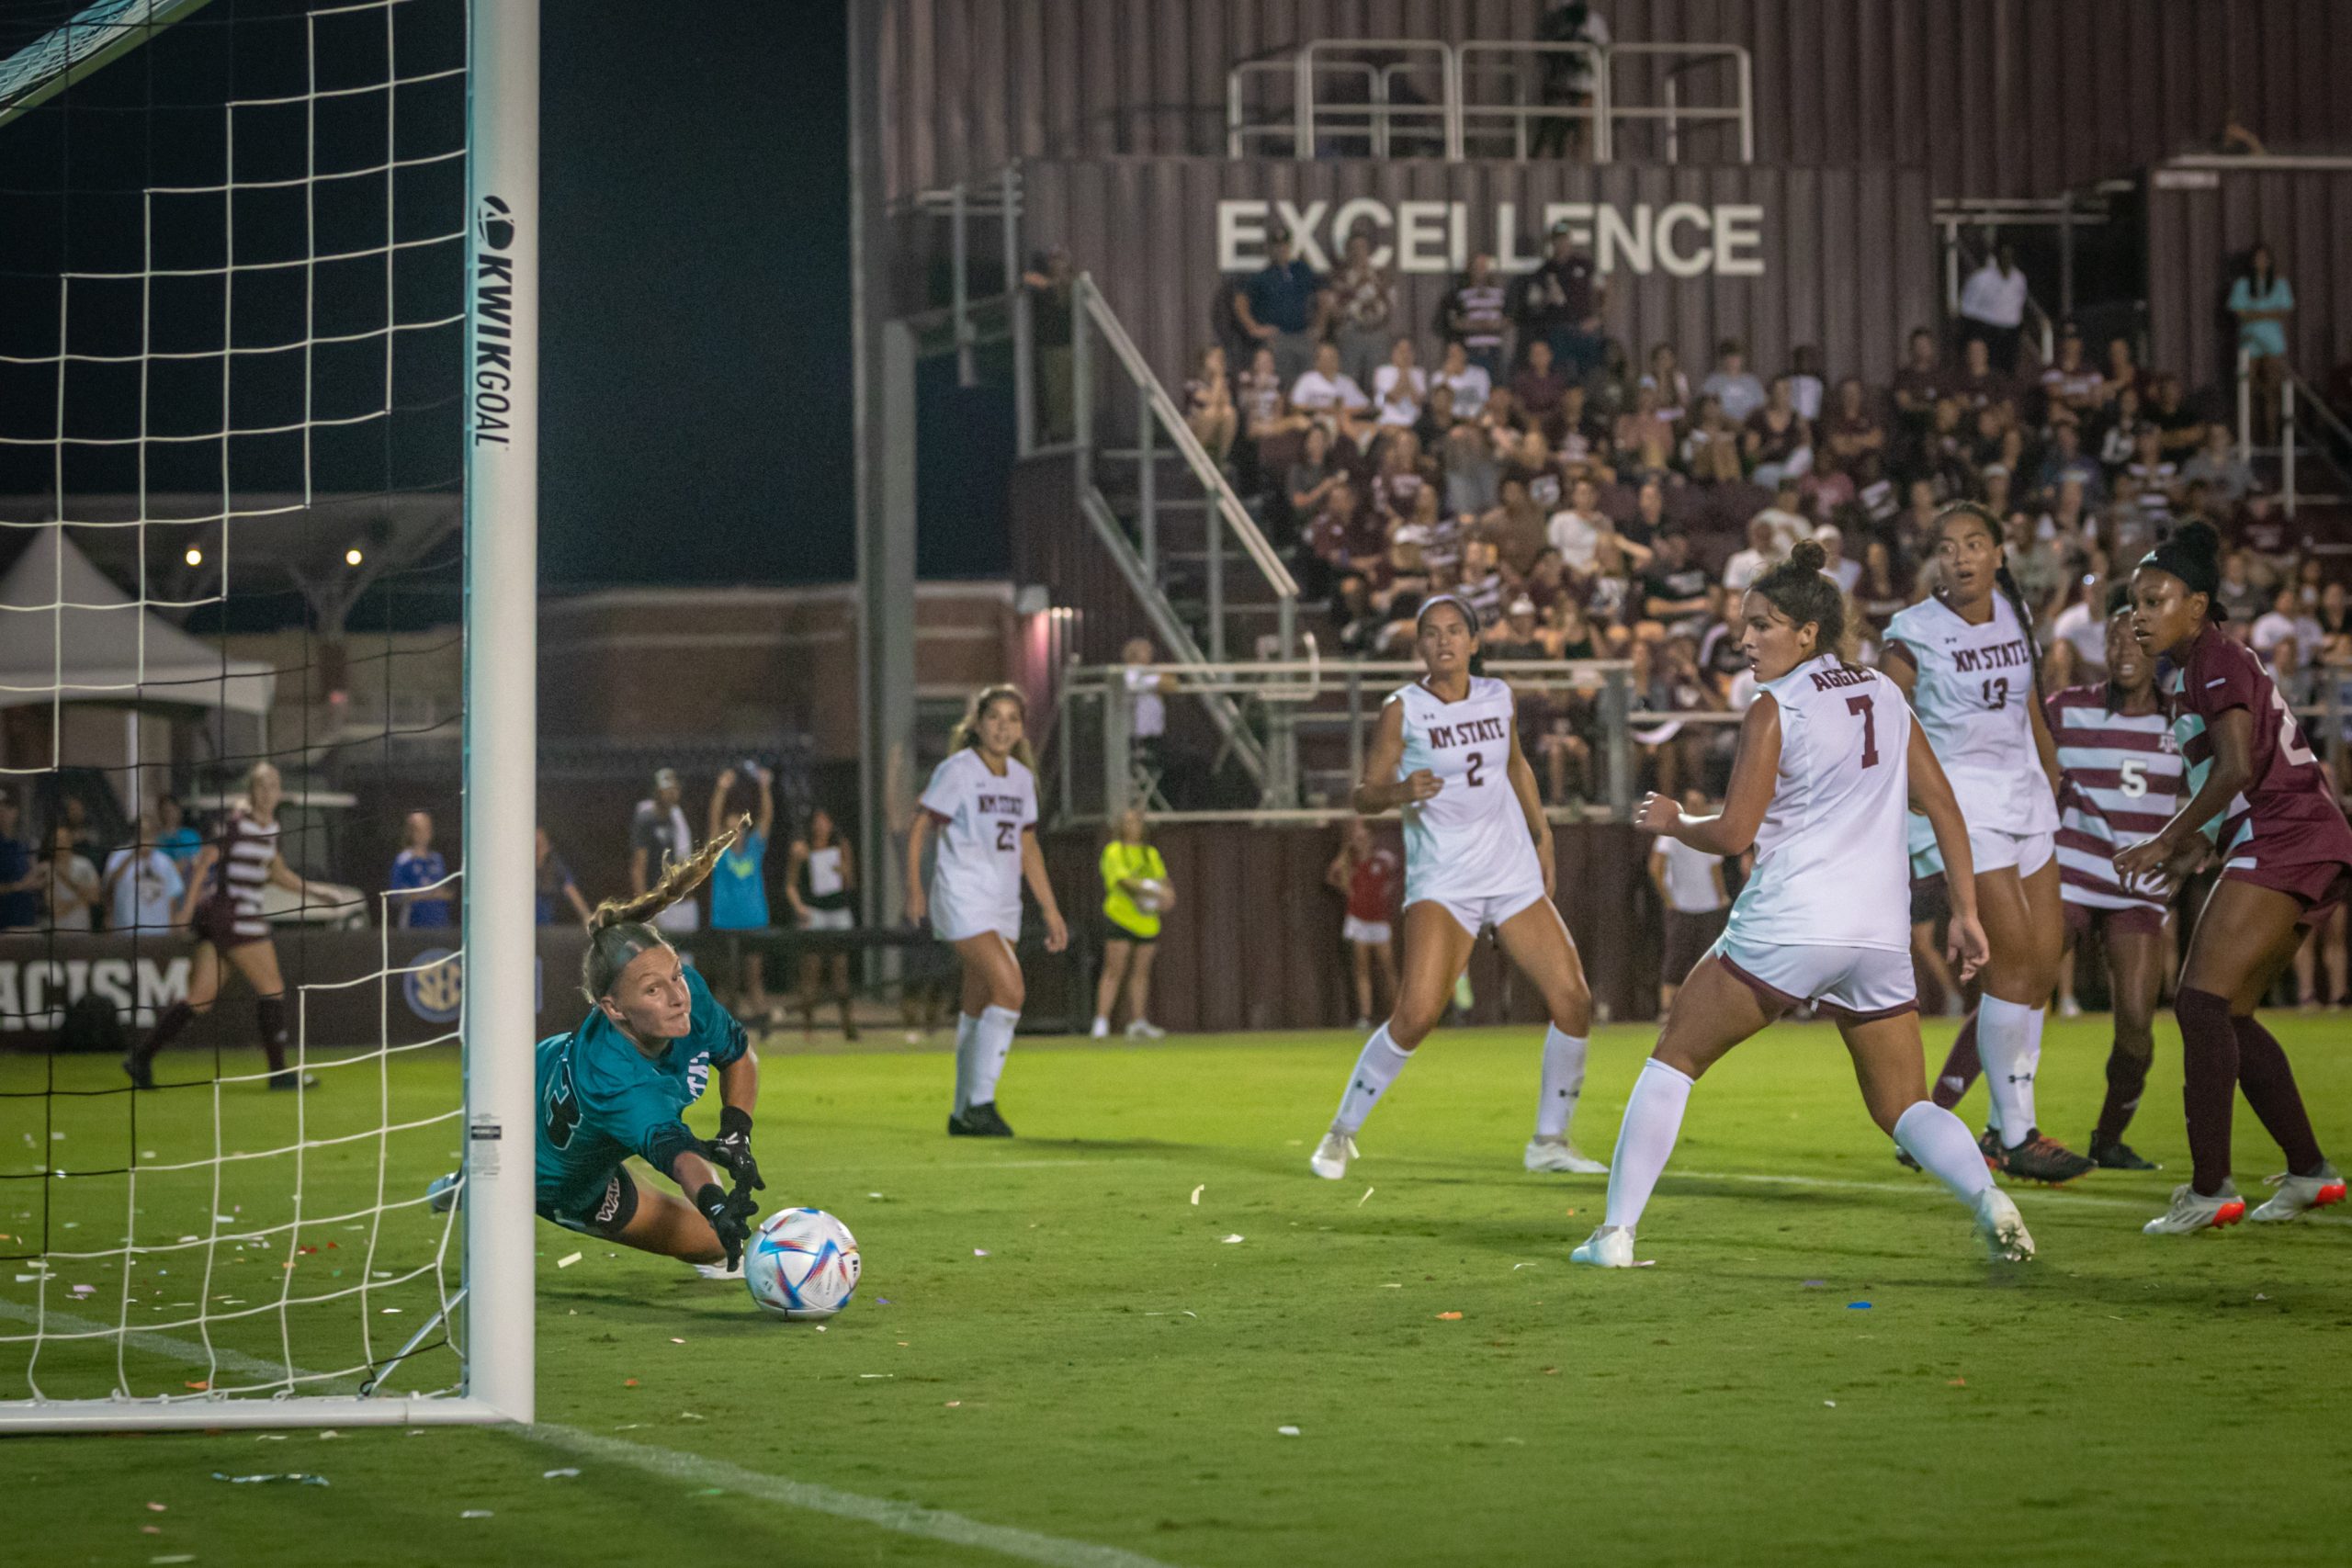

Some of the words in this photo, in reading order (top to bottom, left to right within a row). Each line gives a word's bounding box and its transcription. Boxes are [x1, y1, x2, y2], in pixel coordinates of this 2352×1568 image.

[1951, 649, 1982, 672] NM
[1980, 639, 2030, 670] STATE
[1982, 677, 2008, 710] 13
[1427, 725, 1456, 750] NM
[1455, 716, 1506, 745] STATE
[1845, 694, 1879, 769] 7
[1466, 751, 1485, 787] 2
[2120, 759, 2147, 798] 5
